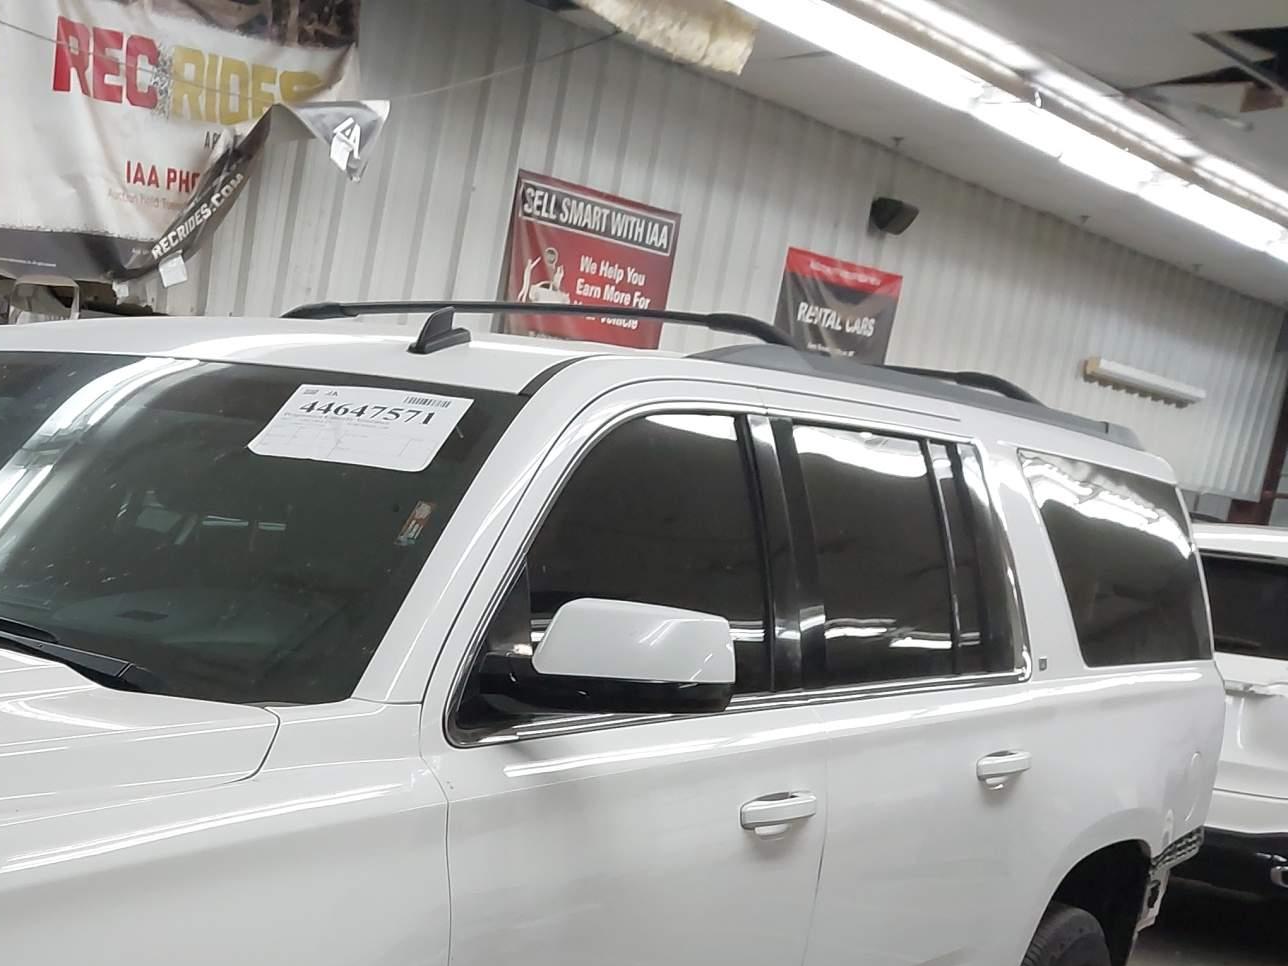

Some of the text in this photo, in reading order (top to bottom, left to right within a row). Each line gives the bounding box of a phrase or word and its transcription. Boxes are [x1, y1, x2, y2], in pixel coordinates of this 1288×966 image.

[53, 16, 158, 109] REC
[126, 160, 159, 188] IAA
[151, 172, 244, 260] RECRIDES.COM
[523, 187, 669, 249] SELL SMART WITH IAA
[579, 255, 646, 287] We Help You
[576, 278, 651, 310] Earn More For
[797, 302, 842, 331] RENTAL
[298, 400, 436, 425] 44647571
